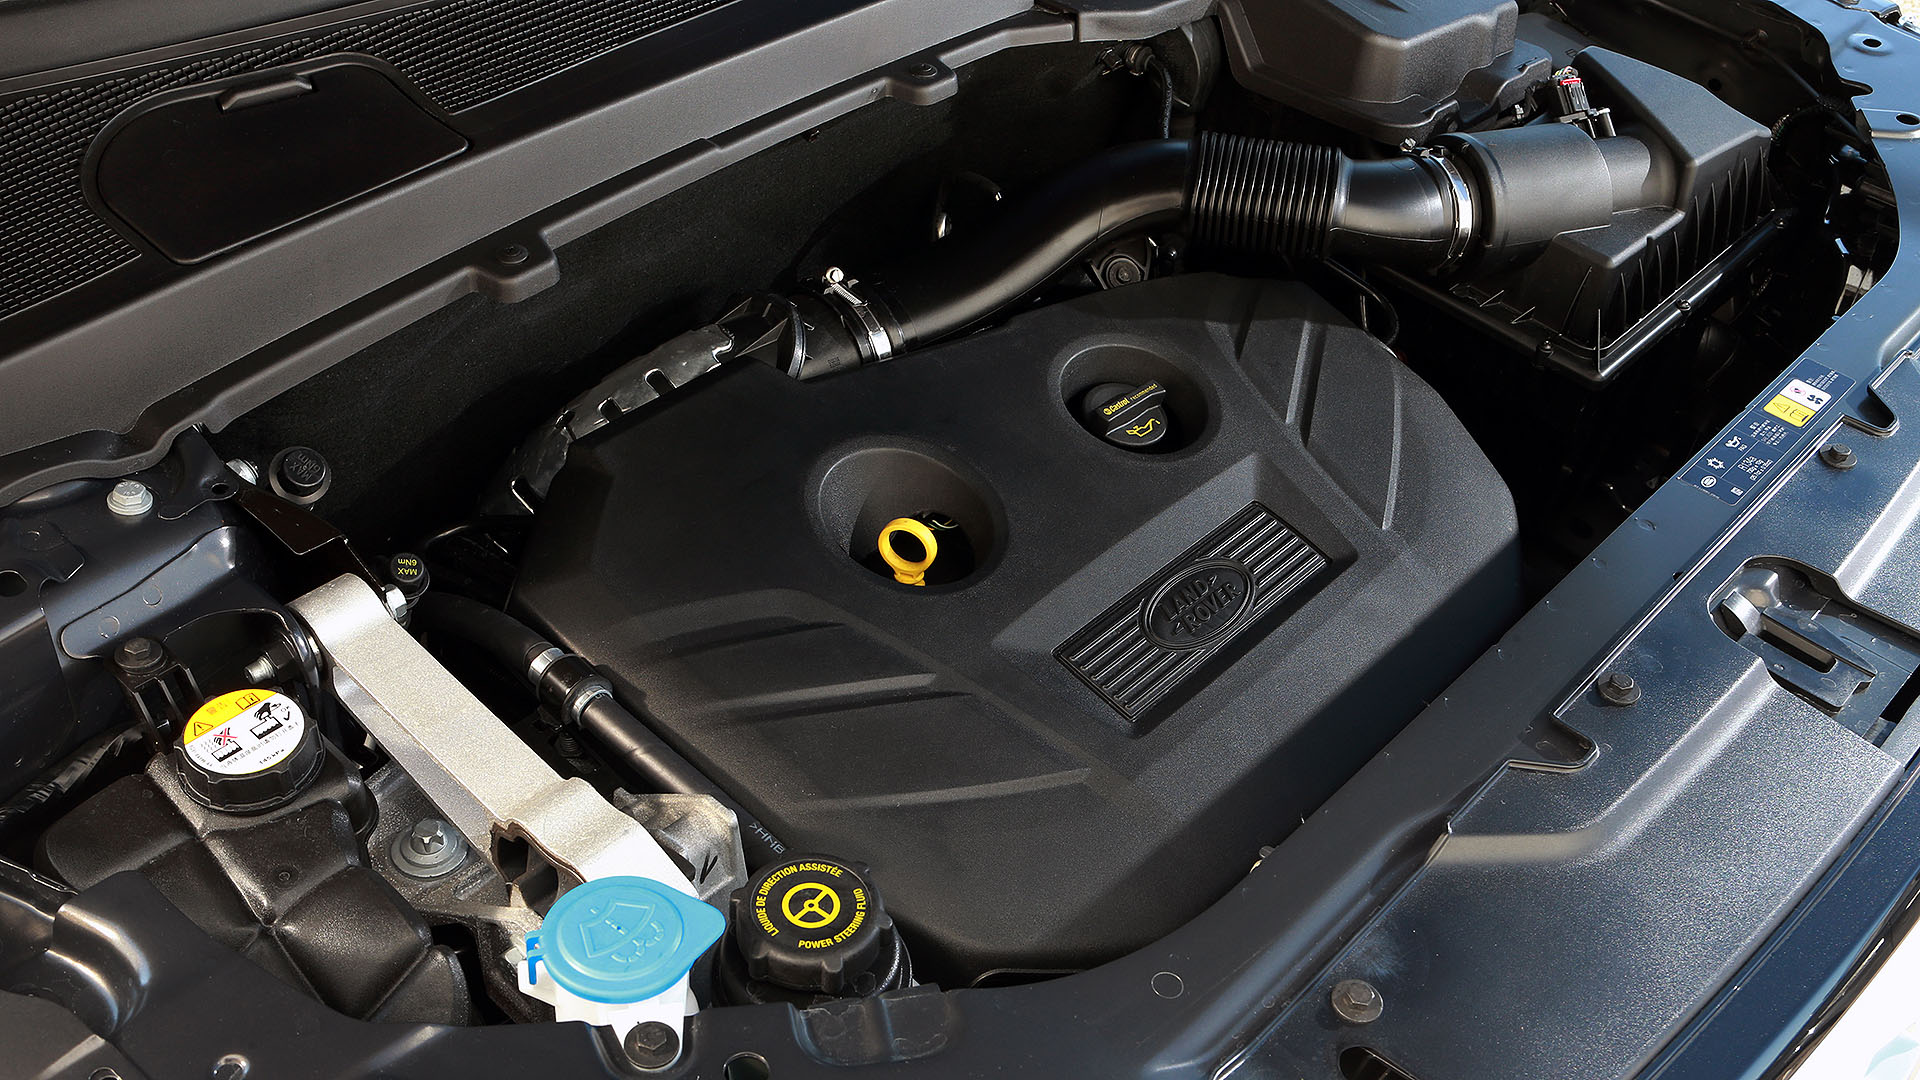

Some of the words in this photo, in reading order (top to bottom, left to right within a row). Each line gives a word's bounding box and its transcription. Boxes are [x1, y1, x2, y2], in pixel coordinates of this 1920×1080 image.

[1109, 397, 1130, 413] Castrol
[290, 462, 313, 481] MAX
[397, 558, 418, 567] 6Nm
[397, 567, 418, 576] MAX
[1160, 579, 1209, 622] LAND
[1180, 583, 1241, 633] ROVER
[799, 863, 843, 878] ASSISTÉE
[758, 865, 798, 896] DIRECTION
[756, 895, 767, 907] DE
[756, 908, 780, 937] LIQUIDE
[798, 938, 834, 949] POWER
[833, 910, 866, 943] STEERING
[853, 888, 866, 910] FLUID
